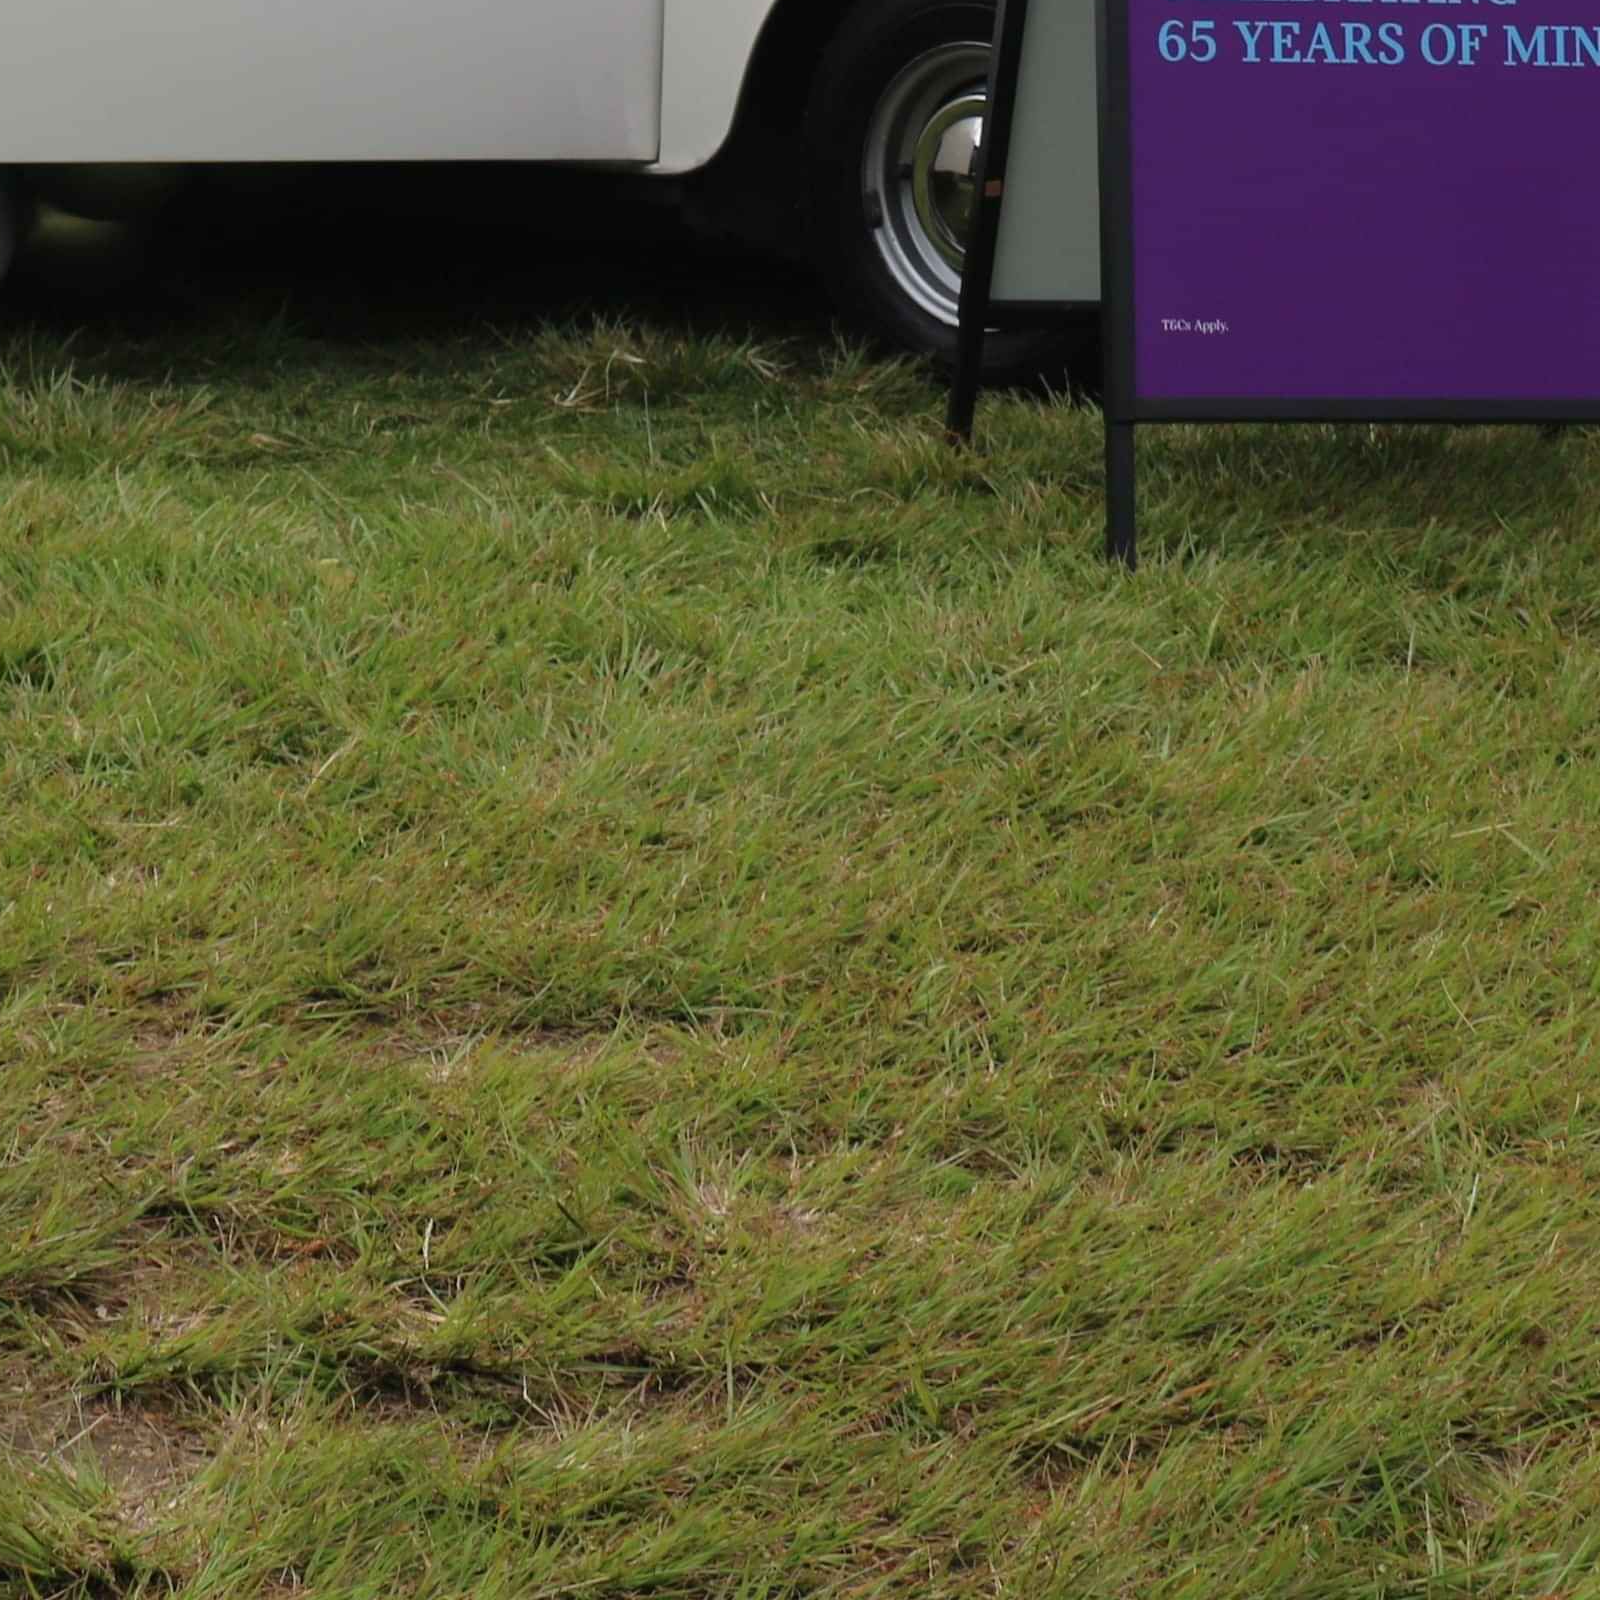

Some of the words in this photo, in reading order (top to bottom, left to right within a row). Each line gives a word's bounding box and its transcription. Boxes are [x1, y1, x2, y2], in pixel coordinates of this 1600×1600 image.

[1157, 19, 1217, 64] 65
[1232, 20, 1405, 65] YEARS
[1420, 23, 1488, 66] OF
